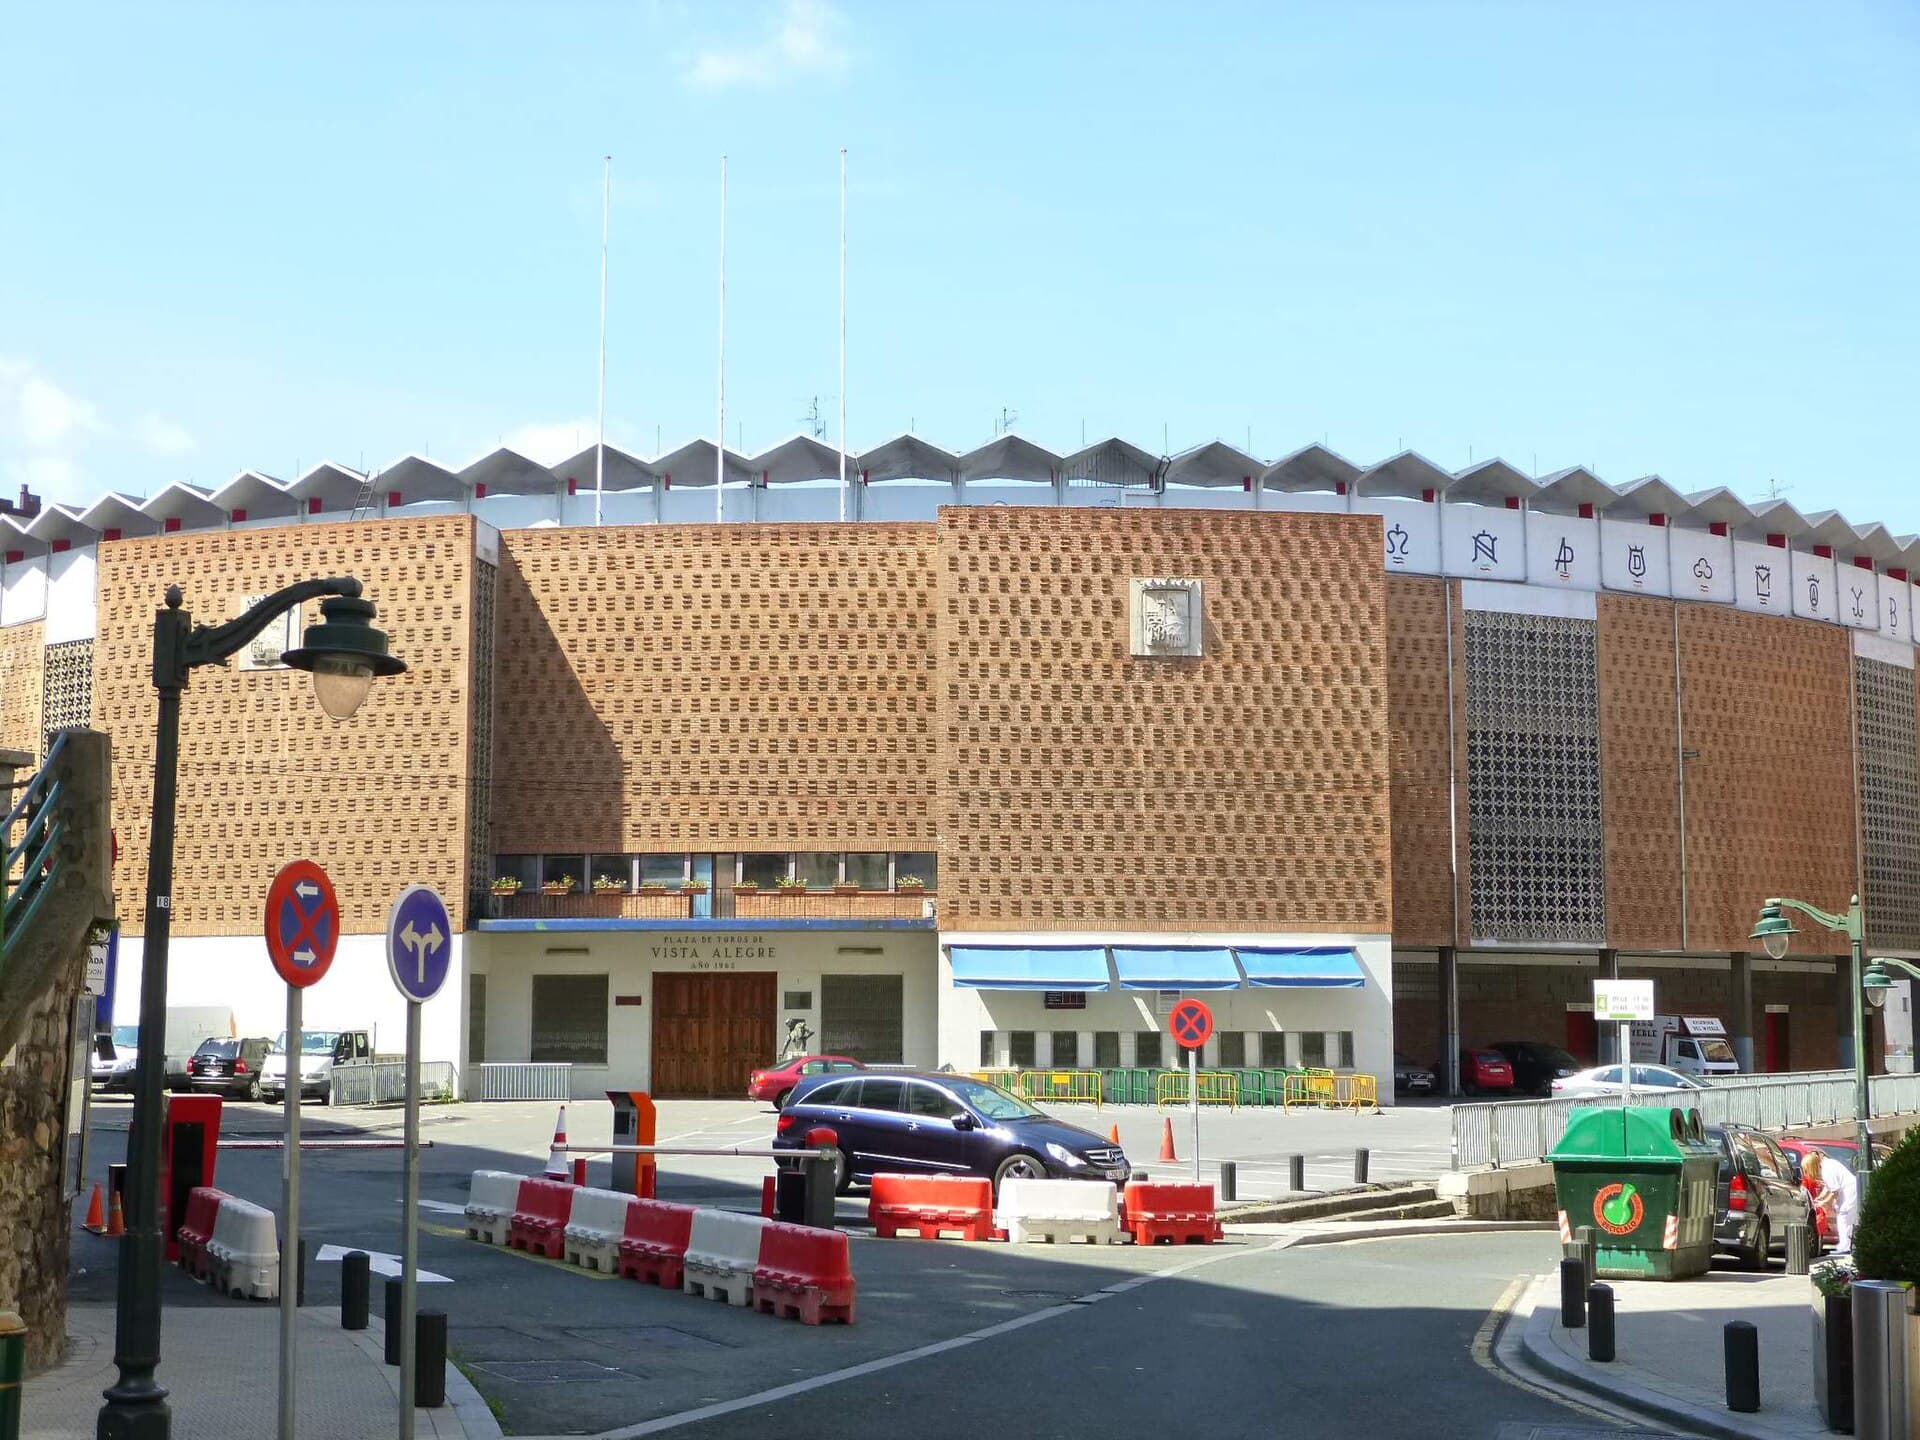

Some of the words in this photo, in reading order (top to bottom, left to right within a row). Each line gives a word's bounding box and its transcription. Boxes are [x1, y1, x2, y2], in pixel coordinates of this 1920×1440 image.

[664, 936, 697, 944] PLAZA
[701, 936, 712, 944] DE
[717, 936, 748, 944] TOROS
[752, 936, 764, 944] DE
[651, 947, 699, 958] VISTA
[712, 947, 776, 958] ALEGRE
[690, 960, 710, 969] AÑO
